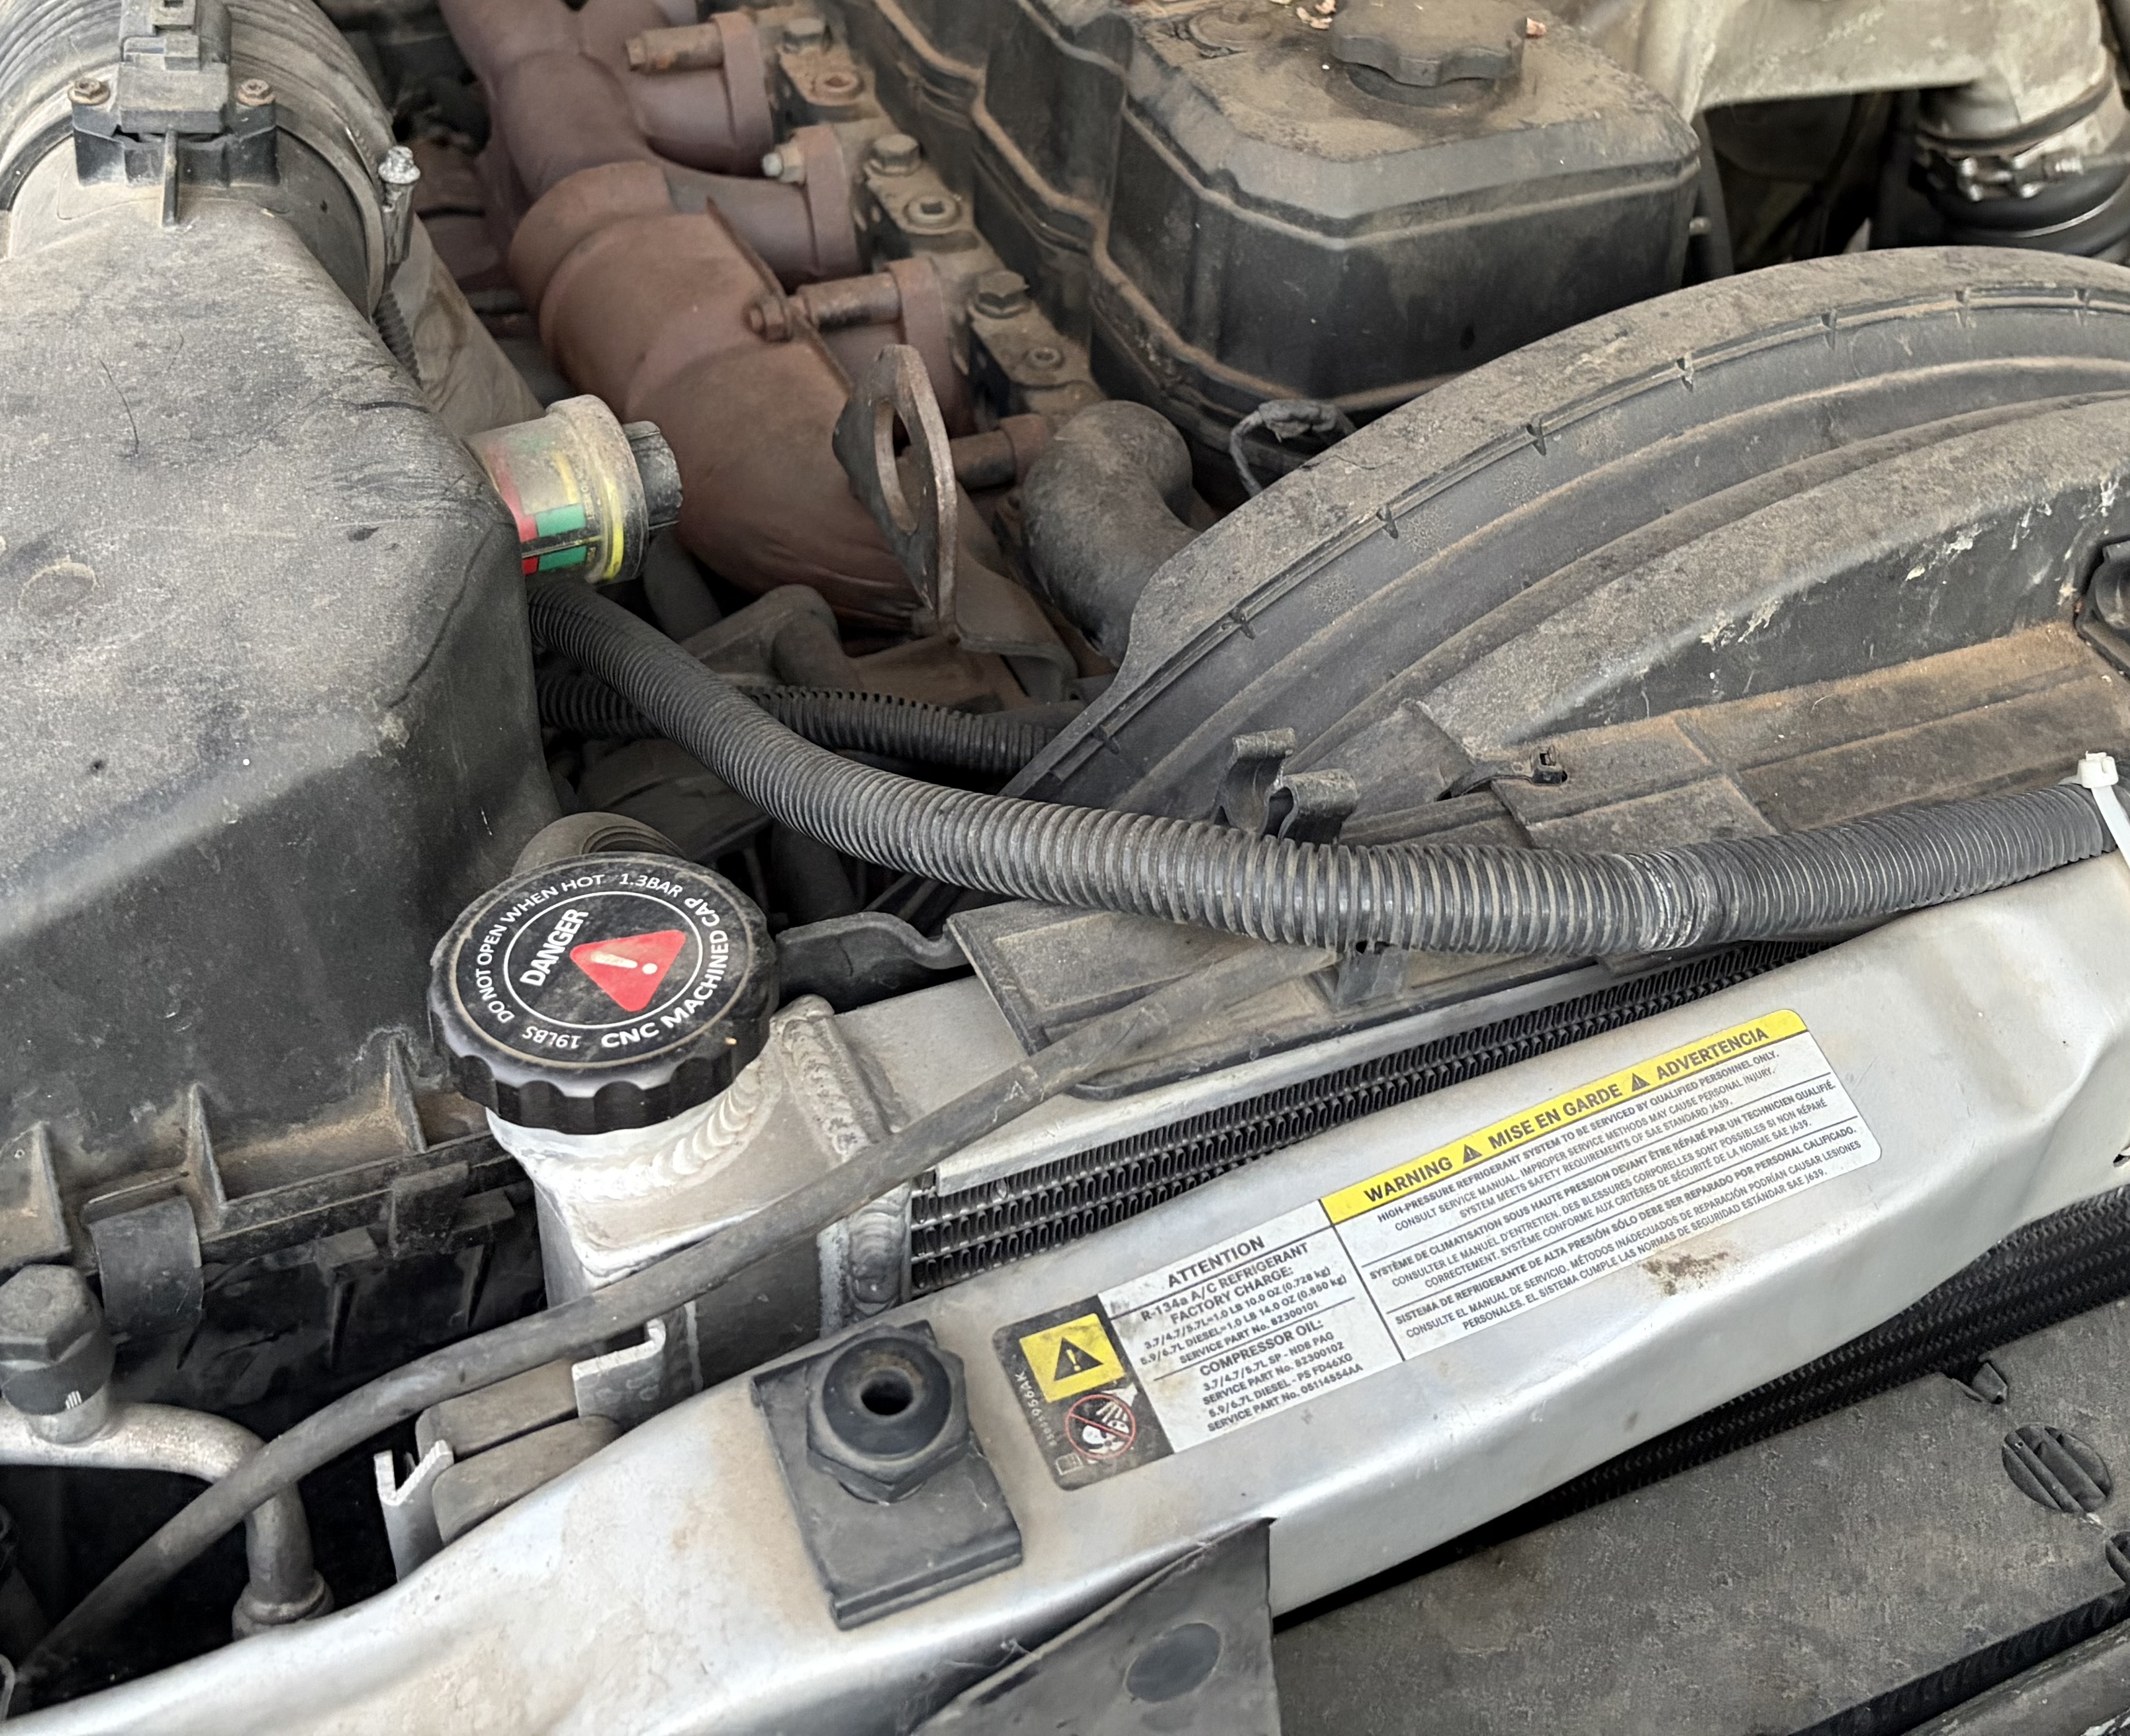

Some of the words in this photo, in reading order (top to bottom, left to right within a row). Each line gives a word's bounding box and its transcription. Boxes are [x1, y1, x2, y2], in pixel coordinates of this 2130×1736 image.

[500, 886, 559, 922] WHEN
[561, 874, 605, 891] HOT
[619, 873, 683, 898] 1.3BAR
[684, 898, 720, 927] CAP
[477, 924, 507, 966] OPEN
[519, 909, 588, 986] DANGER
[476, 968, 497, 1000] NOT
[660, 930, 728, 1028] MACHINED
[488, 1001, 515, 1023] DO
[522, 1026, 582, 1049] 19LBS
[601, 1022, 659, 1047] CNC
[1362, 1156, 1453, 1202] WARNING
[1487, 1119, 1535, 1150] MISE
[1533, 1107, 1562, 1129] EN
[1562, 1082, 1623, 1116] GARDE
[1656, 1027, 1770, 1080] ADVERTENCIA
[1376, 1183, 1456, 1222] HIGH-PRESSURE
[1455, 1153, 1521, 1190] REFRIGERANT
[1521, 1136, 1561, 1160] SYSTEM
[1559, 1131, 1575, 1142] TO
[1574, 1124, 1590, 1137] BE
[1589, 1106, 1636, 1131] SERVICED
[1634, 1100, 1649, 1112] BY
[1649, 1081, 1699, 1106] QUALIFIED
[1698, 1059, 1753, 1087] PERSONNEL
[1752, 1050, 1779, 1065] ONLY.
[1394, 1207, 1437, 1231] CONSULT
[1437, 1190, 1478, 1213] SERVICE
[1519, 1150, 1567, 1177] IMPROPER
[1566, 1134, 1605, 1157] SERVICE
[1604, 1116, 1649, 1141] METHODS
[1647, 1107, 1668, 1123] MAY
[1668, 1096, 1698, 1115] CAUSE
[1697, 1078, 1744, 1103] PERSONAL
[1459, 1196, 1496, 1218] SYSTEM
[1495, 1182, 1527, 1202] MEETS
[1527, 1166, 1561, 1188] SAFETY
[1561, 1138, 1631, 1173] REQUIREMENTS
[1630, 1131, 1643, 1144] OF
[1644, 1125, 1664, 1138] SAE
[1662, 1106, 1708, 1131] STANDARD
[1369, 1255, 1415, 1280] SYSTÈME
[1413, 1249, 1430, 1262] DE
[1428, 1217, 1503, 1255] CLIMATISATION
[1502, 1205, 1531, 1224] SOUS
[1529, 1190, 1564, 1211] HAUTE
[1562, 1170, 1611, 1197] PRESSION
[1610, 1154, 1648, 1177] DEVANT
[1647, 1144, 1673, 1161] ÊTRE
[1671, 1127, 1709, 1151] RÉPARÉ
[1706, 1122, 1727, 1137] PAR
[1725, 1116, 1742, 1128] UN
[1740, 1095, 1795, 1122] TECHNICIEN
[1391, 1259, 1447, 1287] CONSULTER
[1445, 1253, 1460, 1265] LE
[1459, 1236, 1501, 1260] MANUEL
[1561, 1200, 1581, 1215] DES
[1580, 1177, 1632, 1206] BLESSURES
[1632, 1152, 1695, 1184] CORPORELLES
[1694, 1141, 1718, 1158] SONT
[1718, 1122, 1767, 1148] POSSIBLES
[1765, 1118, 1776, 1128] SI
[1775, 1110, 1797, 1124] NON
[1795, 1096, 1828, 1116] RÉPARÉ
[1424, 1251, 1500, 1288] CORRECTEMENT.
[1499, 1231, 1543, 1256] SYSTÈME
[1542, 1208, 1595, 1237] CONFORME
[1594, 1199, 1615, 1215] AUX
[1613, 1182, 1657, 1206] CRITÈRES
[1656, 1176, 1671, 1188] DE
[1669, 1156, 1714, 1182] SÉCURITÉ
[1712, 1153, 1727, 1165] DE
[1725, 1148, 1740, 1159] LA
[1738, 1133, 1772, 1154] NORME
[1771, 1126, 1790, 1140] SAE
[1395, 1301, 1440, 1325] SISTEMA
[1438, 1294, 1455, 1307] DE
[1453, 1263, 1528, 1301] REFRIGERANTE
[1527, 1256, 1543, 1270] DE
[1543, 1246, 1569, 1263] ALTA
[1566, 1226, 1611, 1252] PRESIÓN
[1610, 1214, 1638, 1232] SÓLO
[1637, 1203, 1665, 1221] DEBE
[1663, 1195, 1684, 1210] SER
[1683, 1174, 1734, 1202] REPARADO
[1733, 1165, 1756, 1180] POR
[1753, 1145, 1804, 1172] PERSONAL
[1802, 1125, 1856, 1151] CALIFICADO.
[1405, 1312, 1456, 1338] CONSULTE
[1455, 1307, 1469, 1319] EL
[1467, 1290, 1510, 1313] MANUAL
[1508, 1283, 1524, 1296] DE
[1522, 1264, 1570, 1289] SERVICIO.
[1569, 1243, 1615, 1269] MÉTODOS
[1614, 1215, 1680, 1249] INADECUADOS
[1678, 1209, 1694, 1221] DE
[1692, 1186, 1749, 1215] REPARACIÓN
[1747, 1168, 1788, 1192] PODRÍAN
[1787, 1154, 1823, 1175] CAUSAR
[1821, 1139, 1862, 1161] LESIONES
[1168, 1235, 1265, 1288] ATTENTION
[1190, 1282, 1217, 1302] A/C
[1217, 1241, 1308, 1289] REFRIGERANT
[1461, 1298, 1525, 1330] PERSONALES.
[1524, 1292, 1539, 1304] EL
[1537, 1274, 1580, 1297] SISTEMA
[1578, 1256, 1619, 1279] CUMPLE
[1617, 1248, 1637, 1263] LAS
[1636, 1230, 1677, 1255] NORMAS
[1676, 1224, 1691, 1237] DE
[1689, 1203, 1741, 1231] SEGURIDAD
[1740, 1184, 1787, 1210] ESTÁNDAR
[1786, 1176, 1805, 1190] SAE
[1169, 1290, 1231, 1325] FACTORY
[1233, 1266, 1294, 1297] CHARGE:
[1228, 1302, 1244, 1315] LB
[1266, 1286, 1282, 1298] OZ
[1312, 1265, 1331, 1279] kg)
[1242, 1311, 1258, 1323] LB
[1280, 1294, 1297, 1306] OZ
[1178, 1339, 1224, 1364] SERVICE
[1223, 1327, 1250, 1346] PART
[1250, 1323, 1270, 1334] No.
[1199, 1329, 1295, 1376] COMPRESSOR
[1294, 1319, 1324, 1336] OIL:
[1267, 1353, 1281, 1365] SP
[1311, 1331, 1334, 1346] PAG
[1202, 1381, 1247, 1405] SERVICE
[1247, 1369, 1274, 1387] PART
[1274, 1365, 1294, 1376] No.
[1252, 1378, 1292, 1399] DIESEL
[1296, 1369, 1312, 1381] PS
[1206, 1407, 1253, 1432] SERVICE
[1252, 1395, 1279, 1414] PART
[1280, 1391, 1300, 1403] No.
